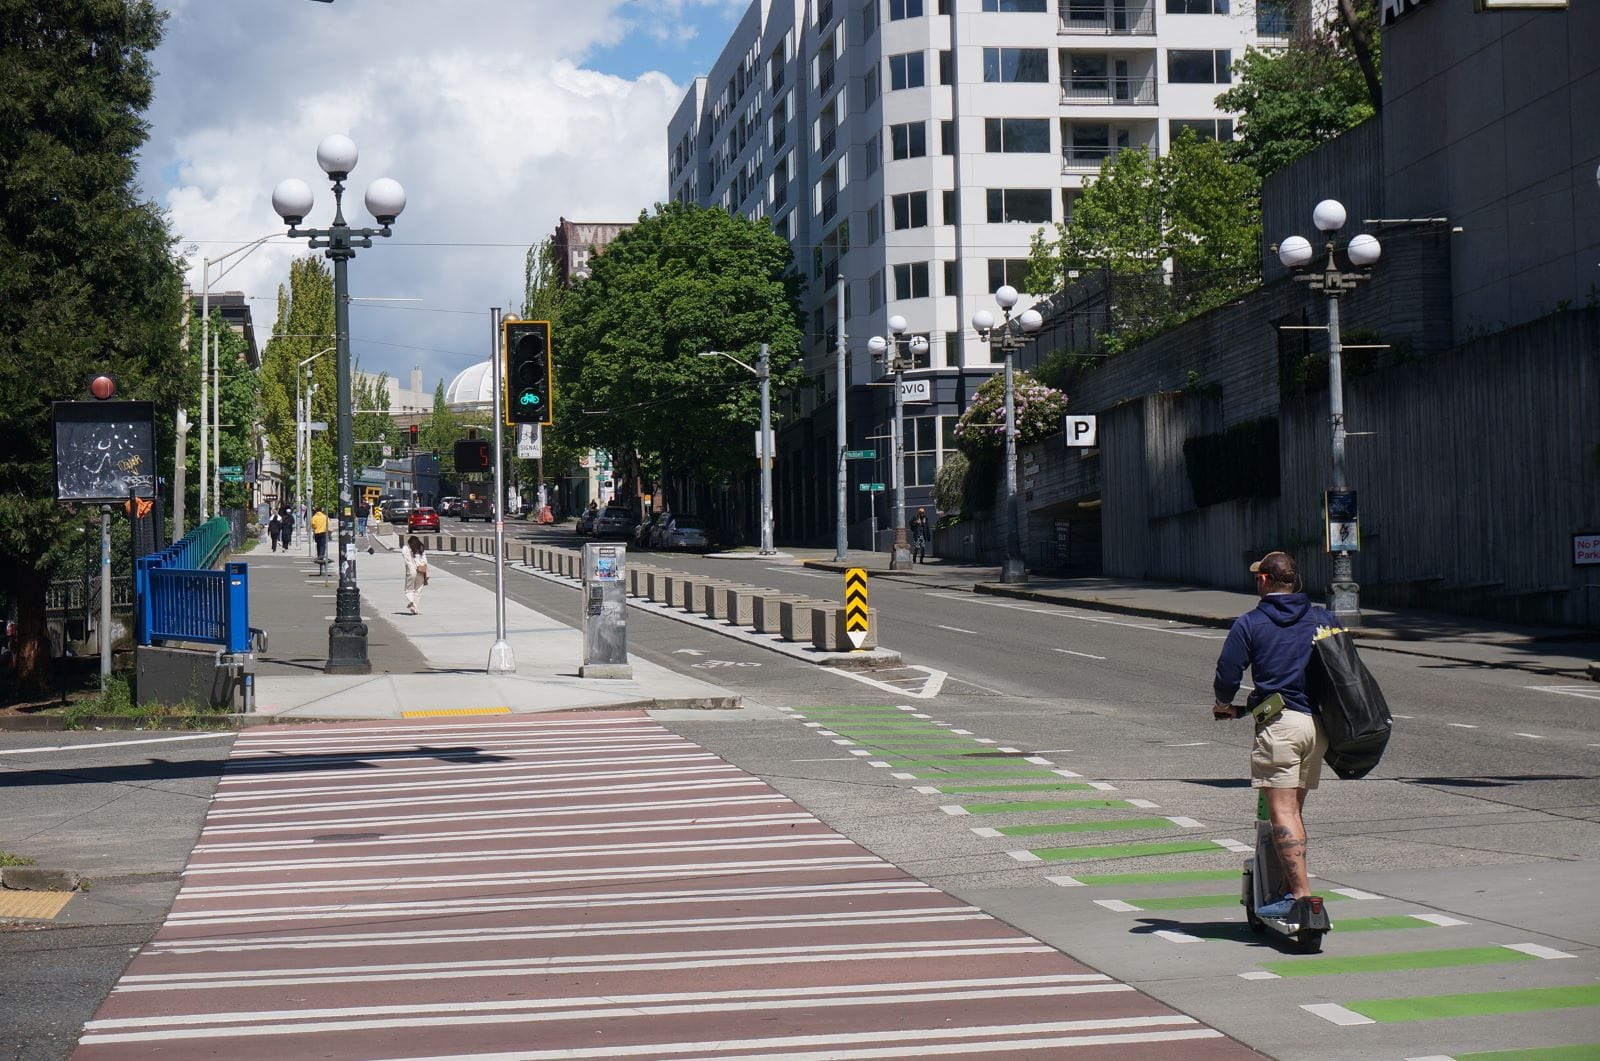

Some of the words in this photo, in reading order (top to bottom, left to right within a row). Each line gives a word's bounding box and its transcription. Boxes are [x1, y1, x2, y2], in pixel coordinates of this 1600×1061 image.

[1074, 420, 1089, 441] P
[479, 446, 489, 466] 5
[1577, 540, 1591, 549] No
